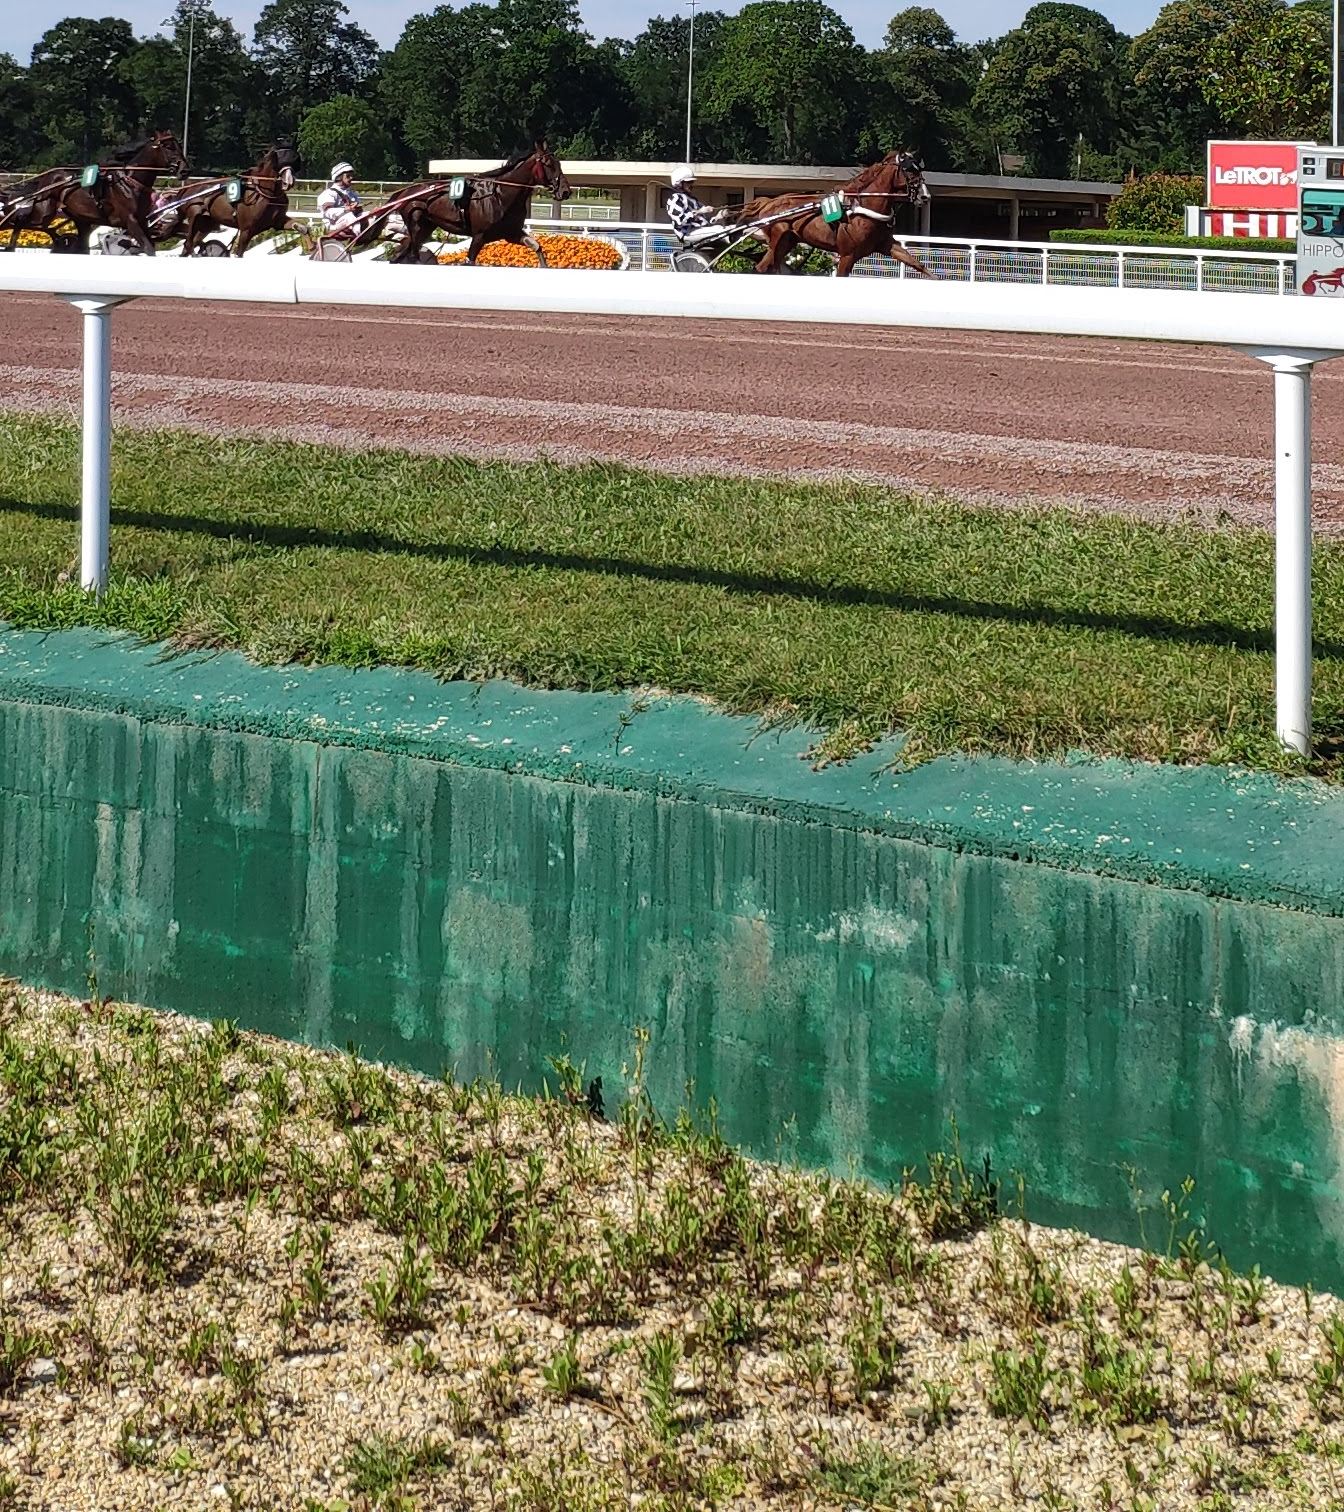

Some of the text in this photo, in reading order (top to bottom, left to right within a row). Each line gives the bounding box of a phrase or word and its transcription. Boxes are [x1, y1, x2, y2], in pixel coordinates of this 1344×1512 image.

[85, 168, 94, 183] 1
[1215, 166, 1282, 185] LeTROT
[228, 182, 238, 199] 9
[449, 178, 464, 197] 10
[822, 195, 838, 215] 11
